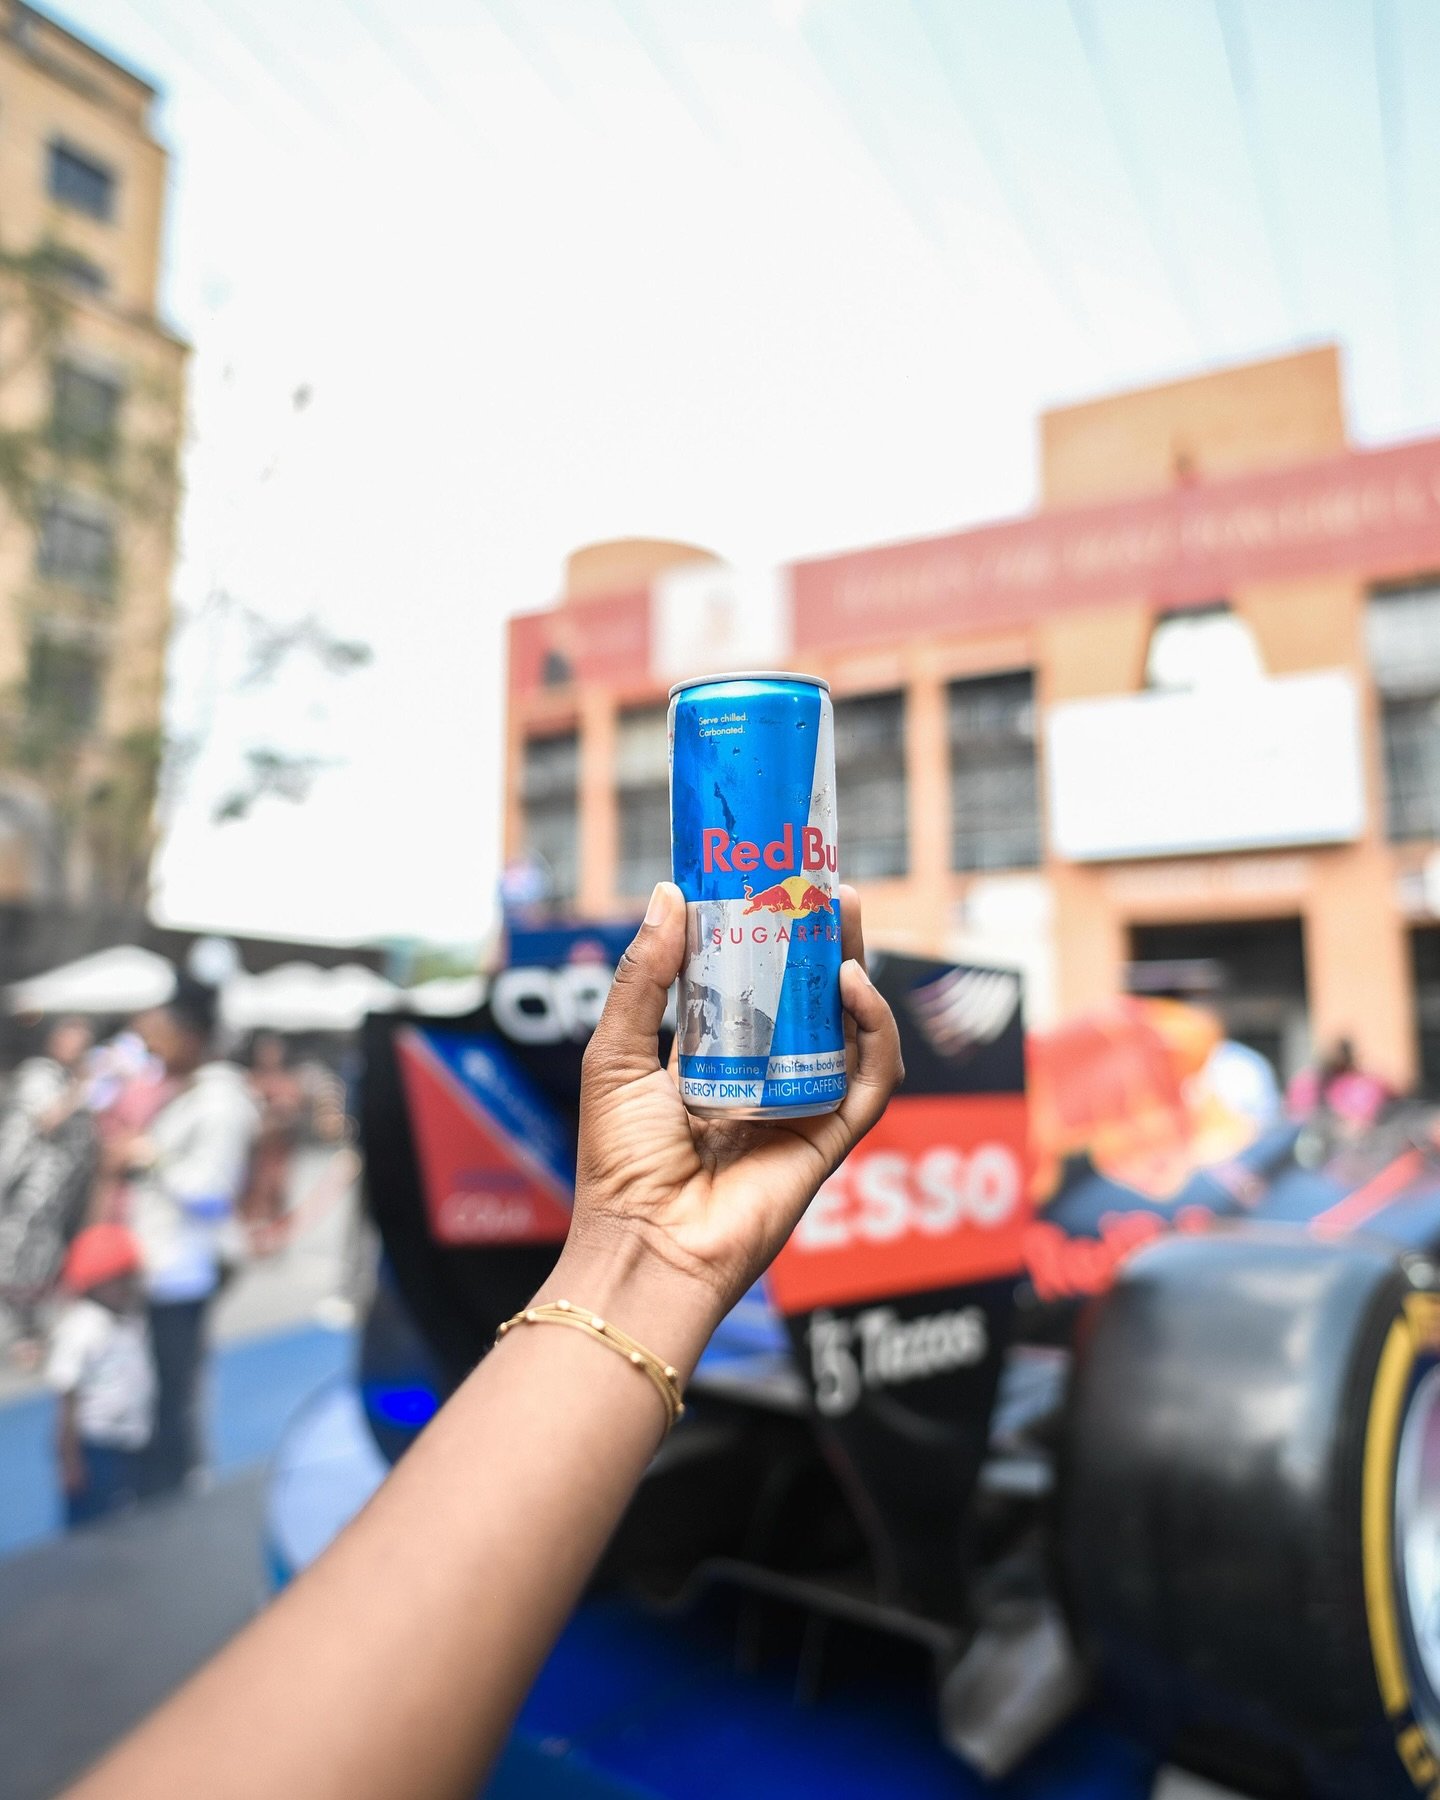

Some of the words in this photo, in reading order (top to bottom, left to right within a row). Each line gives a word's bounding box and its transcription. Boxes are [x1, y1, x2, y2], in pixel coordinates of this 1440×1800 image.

[699, 716, 719, 726] Serve
[720, 711, 749, 723] chilled.
[699, 725, 746, 737] Carbonated.
[702, 823, 795, 873] Red
[695, 1062, 716, 1075] With
[719, 1062, 763, 1075] Taurine.
[816, 1058, 835, 1072] body
[684, 1081, 716, 1097] ENERGY
[720, 1083, 757, 1098] DRINK
[768, 1081, 801, 1097] HIGH
[803, 1076, 843, 1095] CAFFEINE
